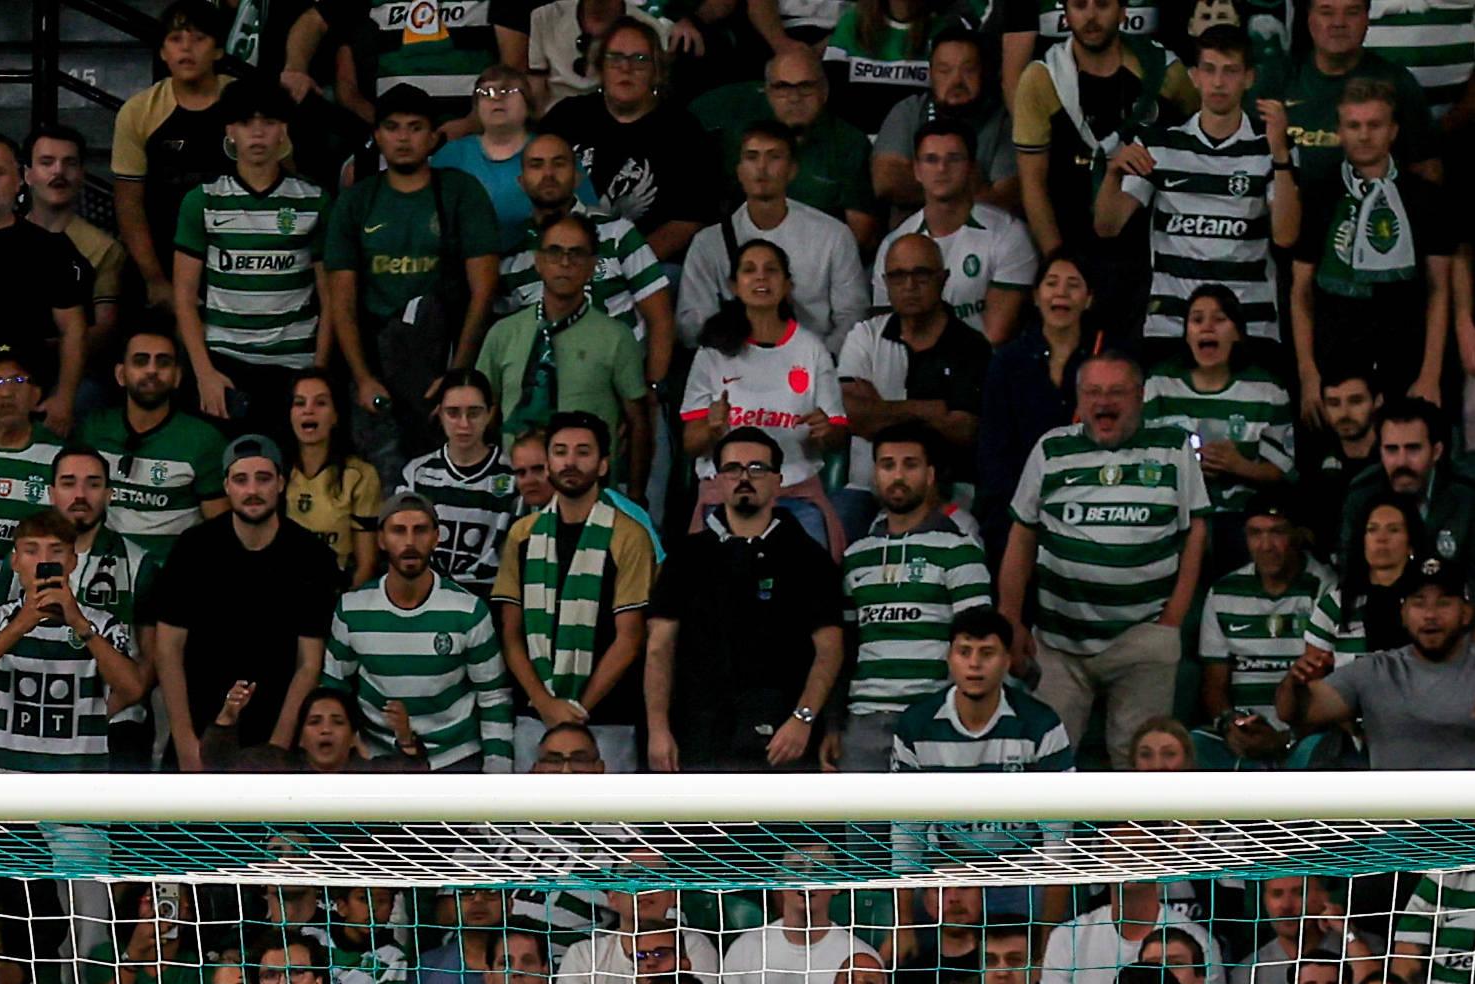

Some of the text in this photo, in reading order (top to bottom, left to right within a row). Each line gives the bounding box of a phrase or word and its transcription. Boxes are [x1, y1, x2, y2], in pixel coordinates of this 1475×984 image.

[853, 62, 927, 82] SPORTING
[1165, 212, 1249, 238] Betano
[235, 253, 295, 271] BETANO
[1083, 506, 1151, 522] BETANO
